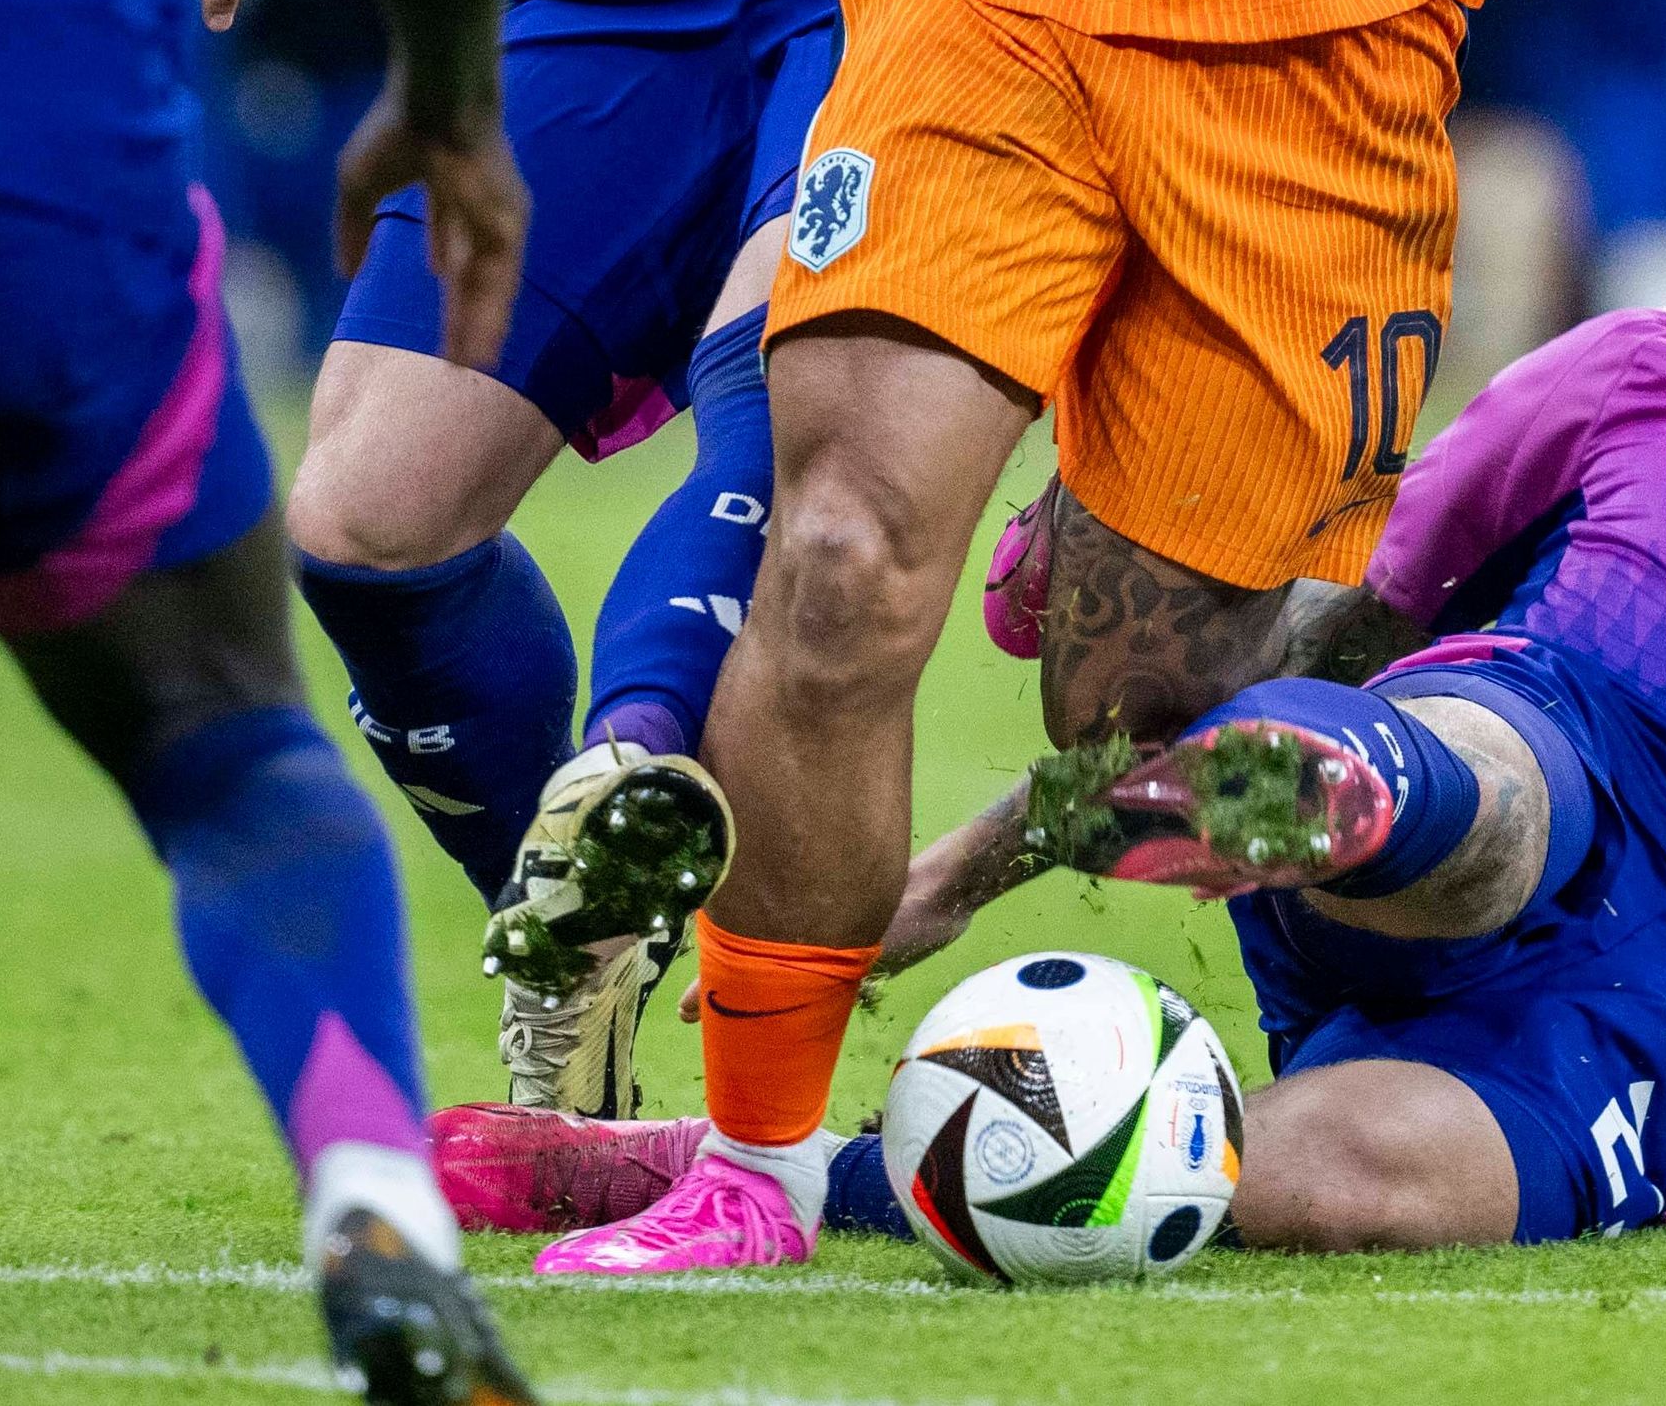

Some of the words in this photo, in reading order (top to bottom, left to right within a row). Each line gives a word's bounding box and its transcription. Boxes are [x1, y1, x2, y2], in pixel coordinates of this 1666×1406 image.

[1320, 309, 1442, 482] 10
[710, 492, 770, 535] D
[350, 684, 456, 754] FB
